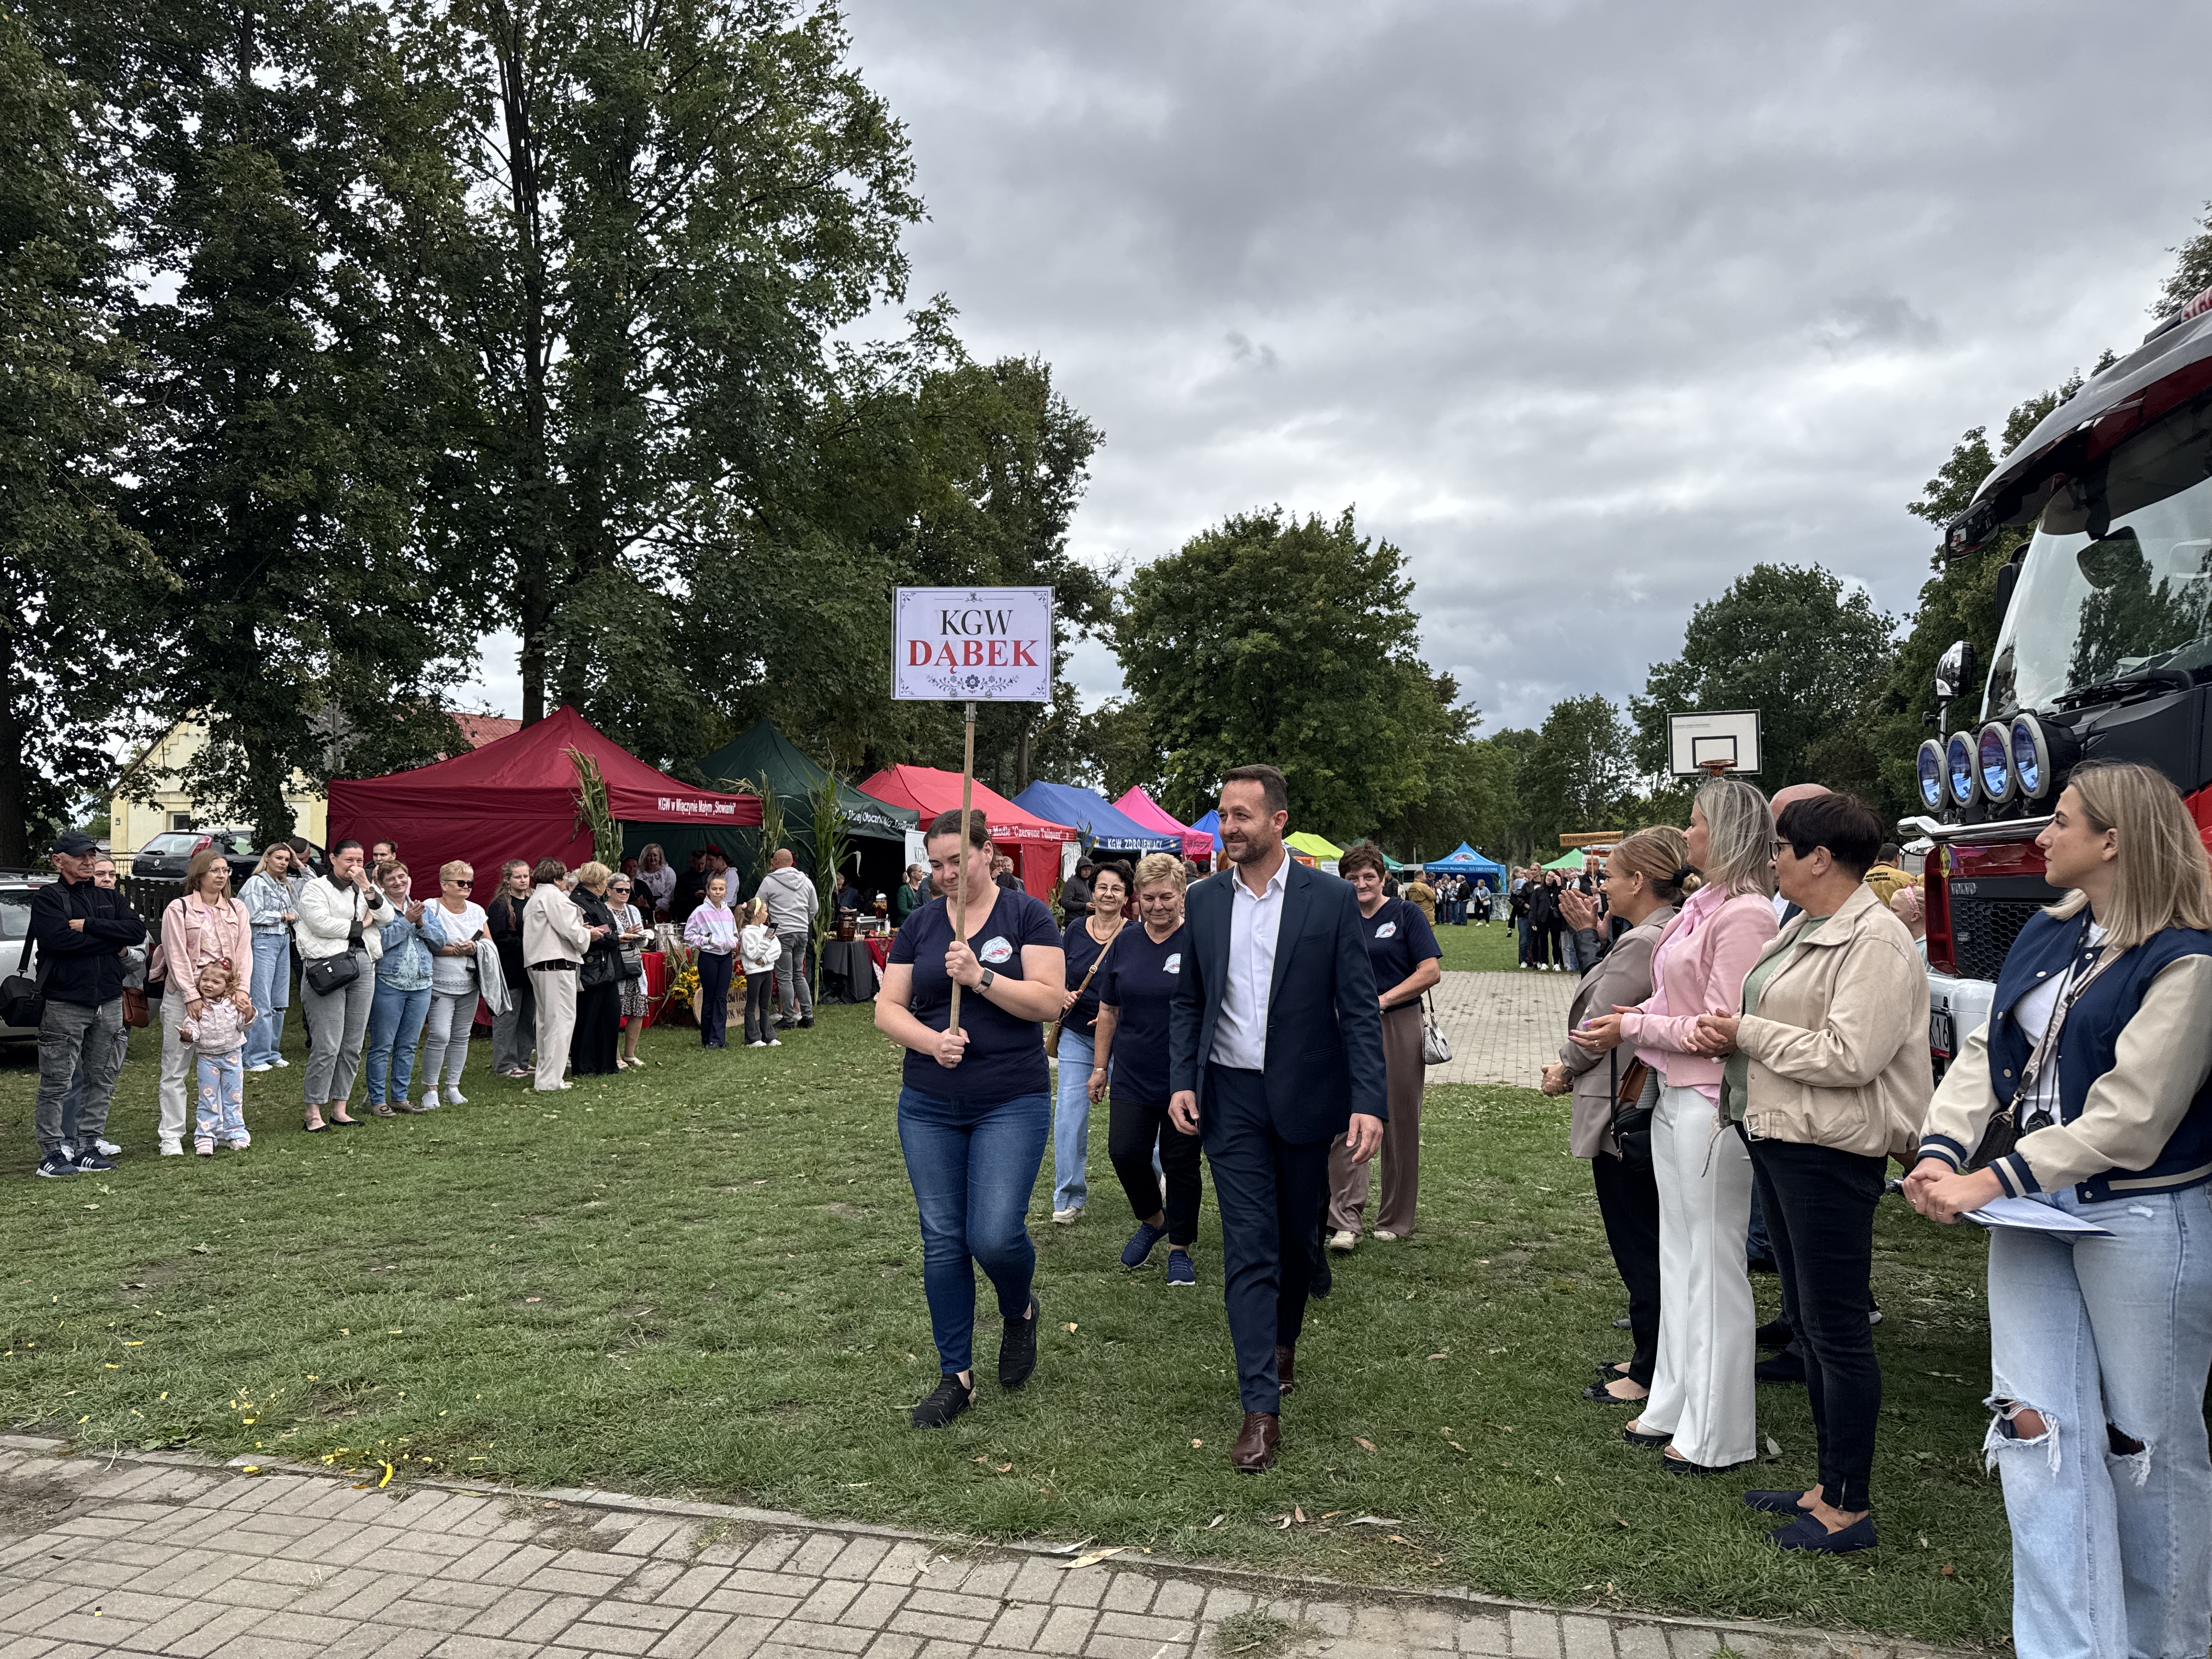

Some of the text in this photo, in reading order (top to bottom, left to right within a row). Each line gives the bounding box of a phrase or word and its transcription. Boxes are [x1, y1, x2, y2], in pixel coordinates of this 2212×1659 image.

[940, 610, 1014, 635] KGW
[906, 640, 1040, 674] DĄBEK
[658, 797, 670, 811] KGW
[671, 801, 676, 811] w
[1107, 838, 1122, 850] KGW
[914, 847, 927, 863] KGW
[1950, 882, 1977, 895] VOLVO
